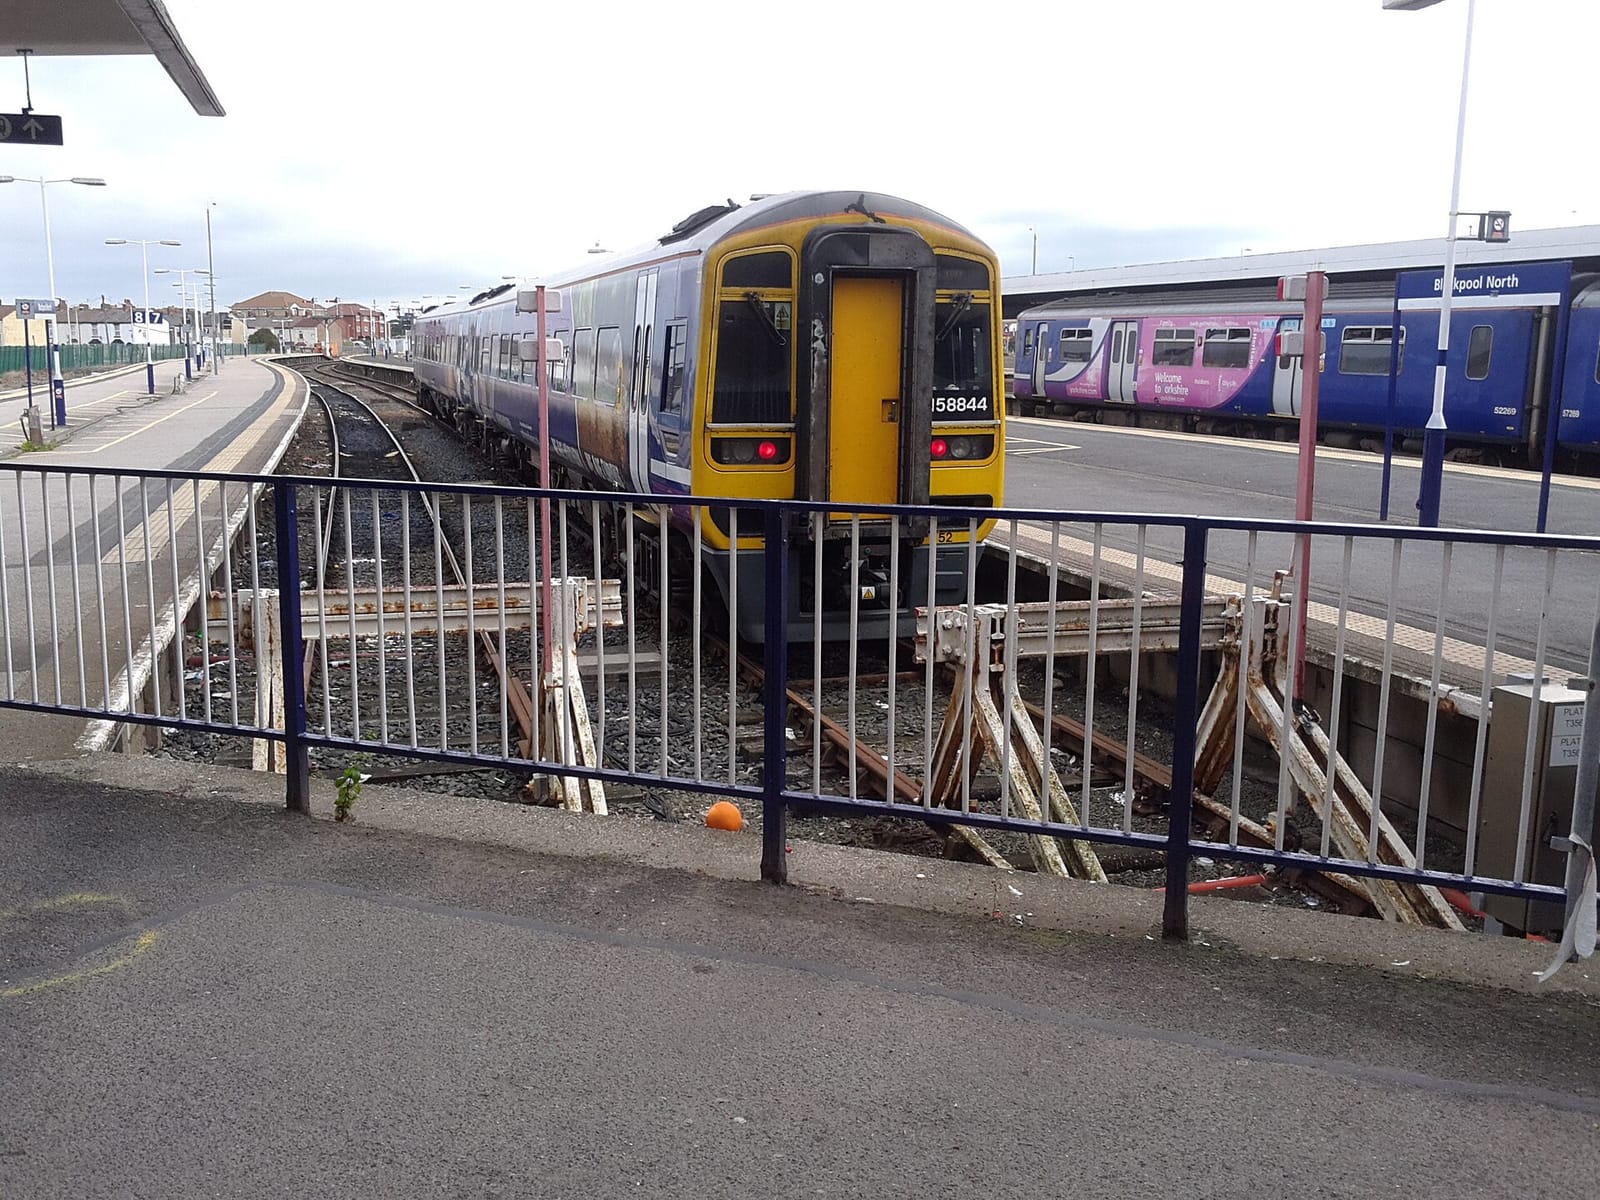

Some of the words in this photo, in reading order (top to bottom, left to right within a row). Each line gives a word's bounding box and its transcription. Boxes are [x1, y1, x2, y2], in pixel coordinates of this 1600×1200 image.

[1433, 275, 1482, 293] Blkpool
[1486, 273, 1518, 289] North
[134, 312, 144, 323] 8
[151, 312, 160, 323] 7
[1154, 372, 1182, 384] Welcome
[1154, 384, 1161, 394] to
[1163, 384, 1189, 396] orkshire
[931, 397, 988, 412] 158844
[1493, 406, 1517, 416] 52269
